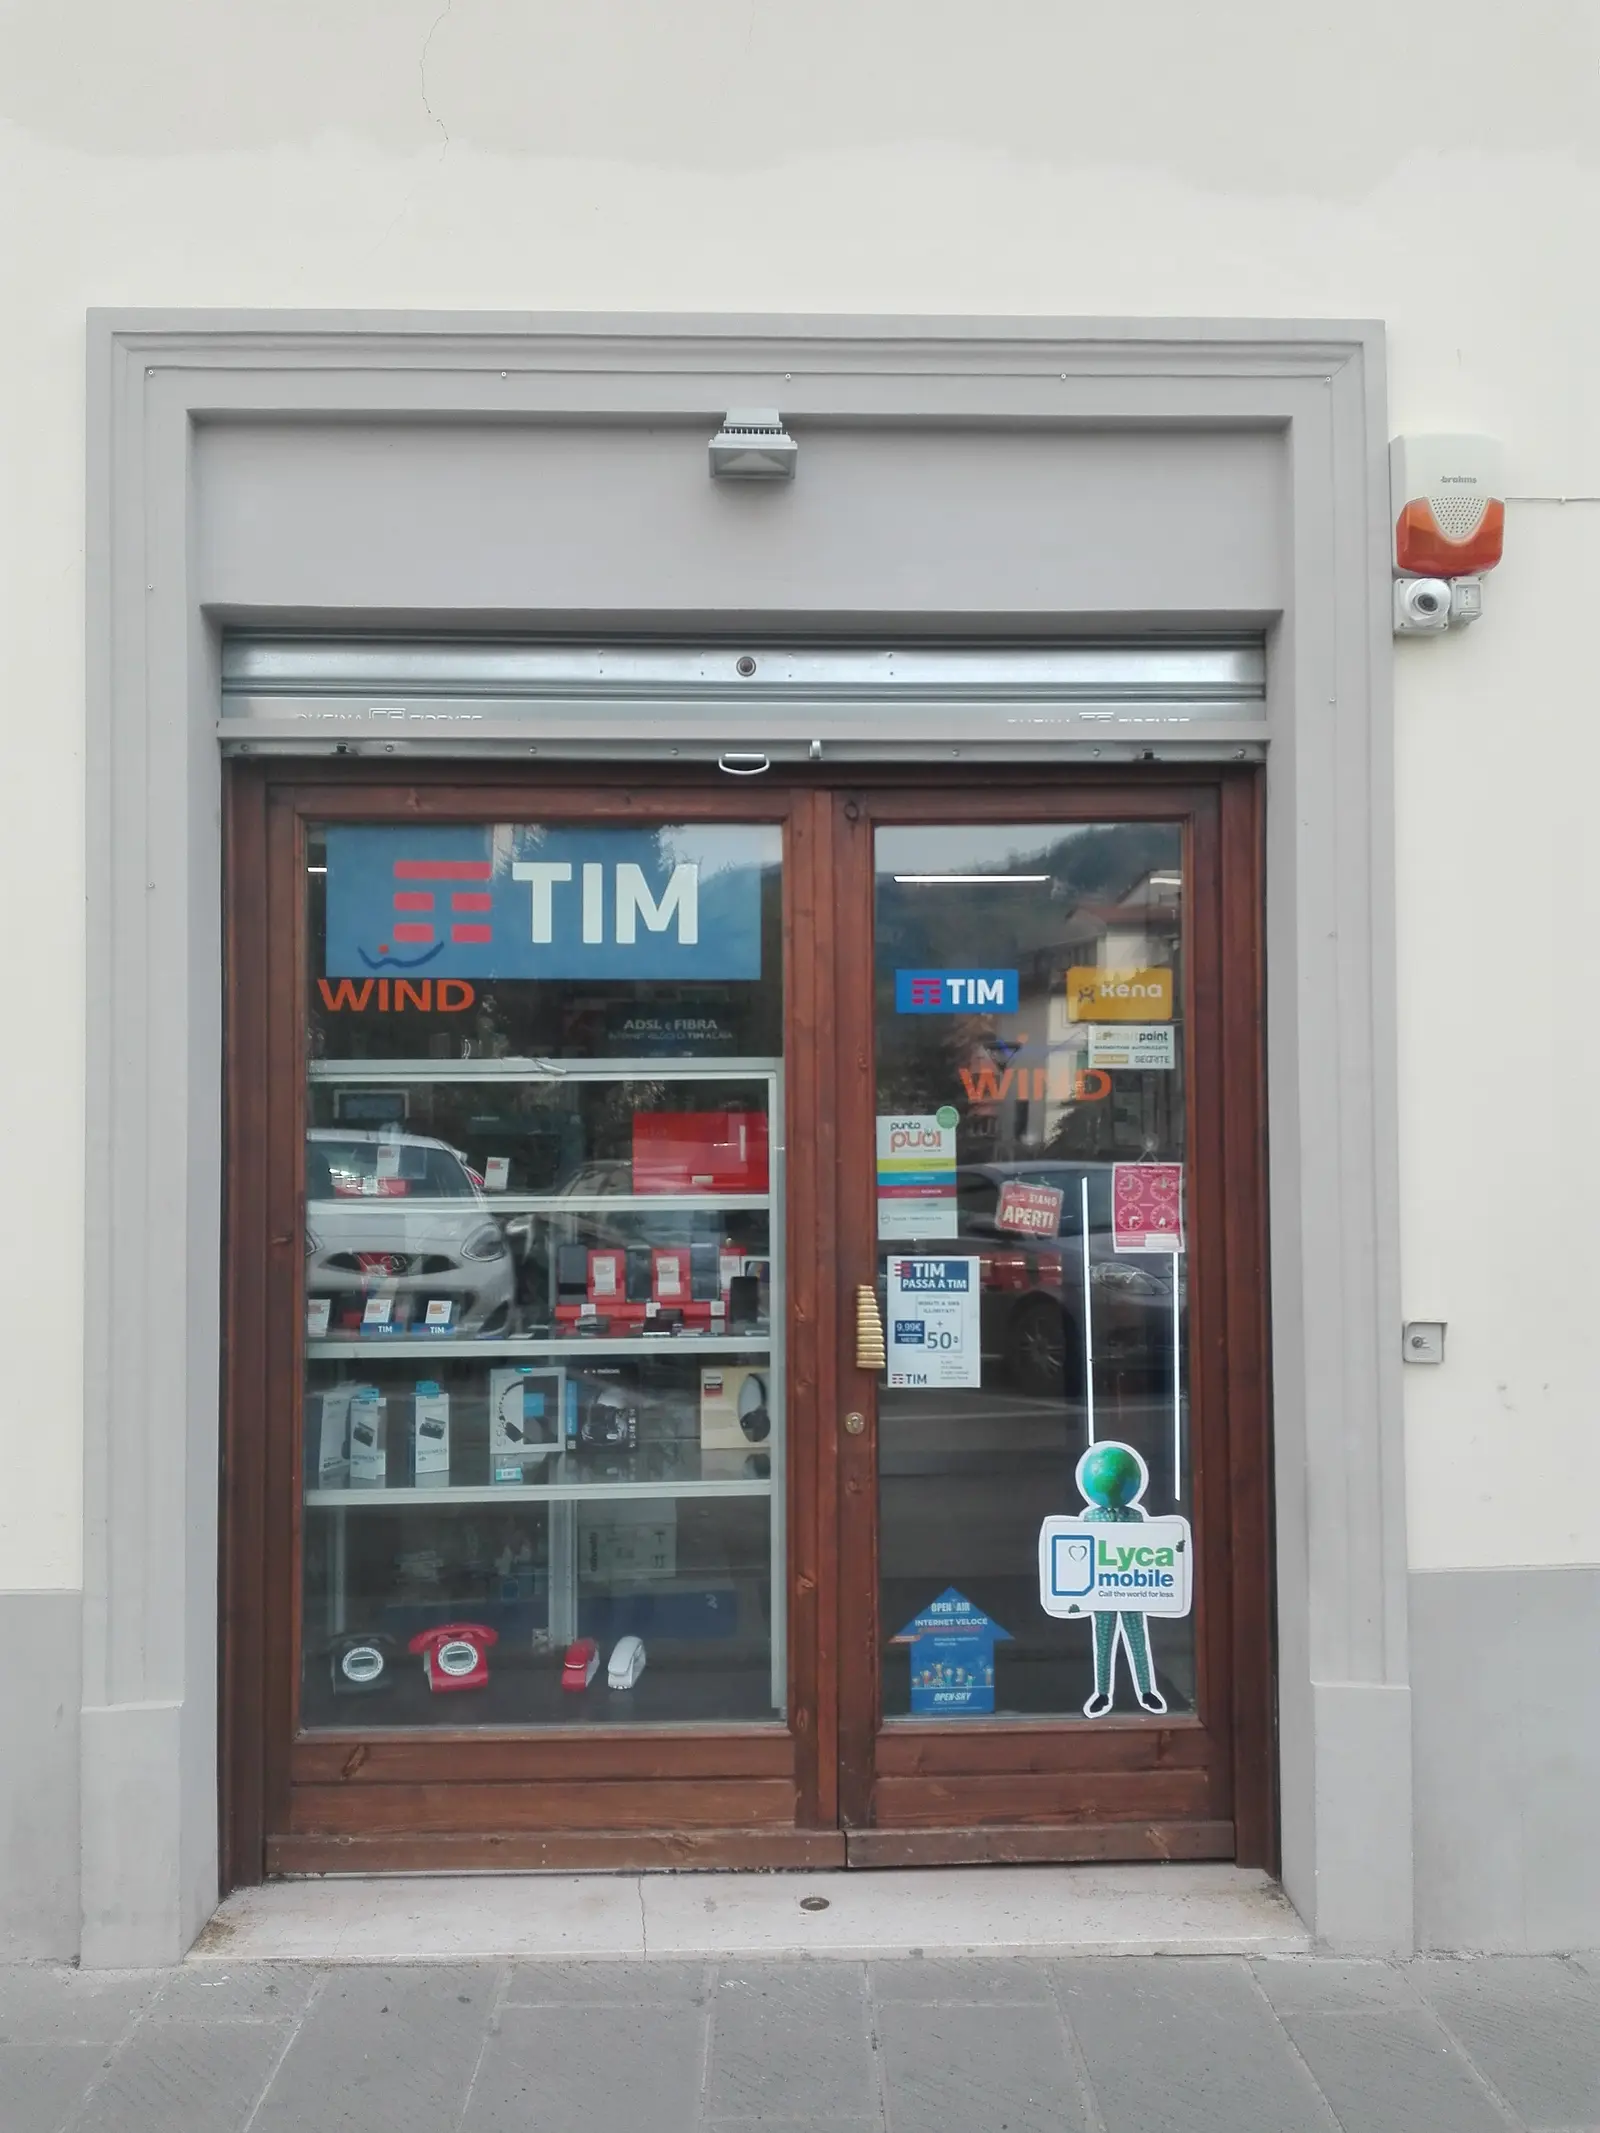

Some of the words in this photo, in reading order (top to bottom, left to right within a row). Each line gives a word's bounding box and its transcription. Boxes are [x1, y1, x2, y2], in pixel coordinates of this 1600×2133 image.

[512, 863, 699, 945] TIM
[318, 979, 474, 1011] WIND
[946, 979, 1004, 1004] TIM
[624, 1019, 661, 1030] ADSL
[674, 1019, 717, 1030] FIBRA
[959, 1068, 1112, 1101] WIND
[890, 1122, 920, 1132] punto
[913, 1263, 945, 1277] TIM
[903, 1279, 935, 1288] PASSA
[938, 1280, 945, 1288] A
[948, 1280, 967, 1288] TIM
[927, 1332, 952, 1349] 50
[906, 1374, 927, 1384] TIM
[1099, 1540, 1174, 1571] Lyca
[1099, 1569, 1174, 1587] mobile
[931, 1602, 952, 1613] OPEN
[956, 1602, 970, 1612] AIR
[955, 1618, 988, 1626] VELOCE
